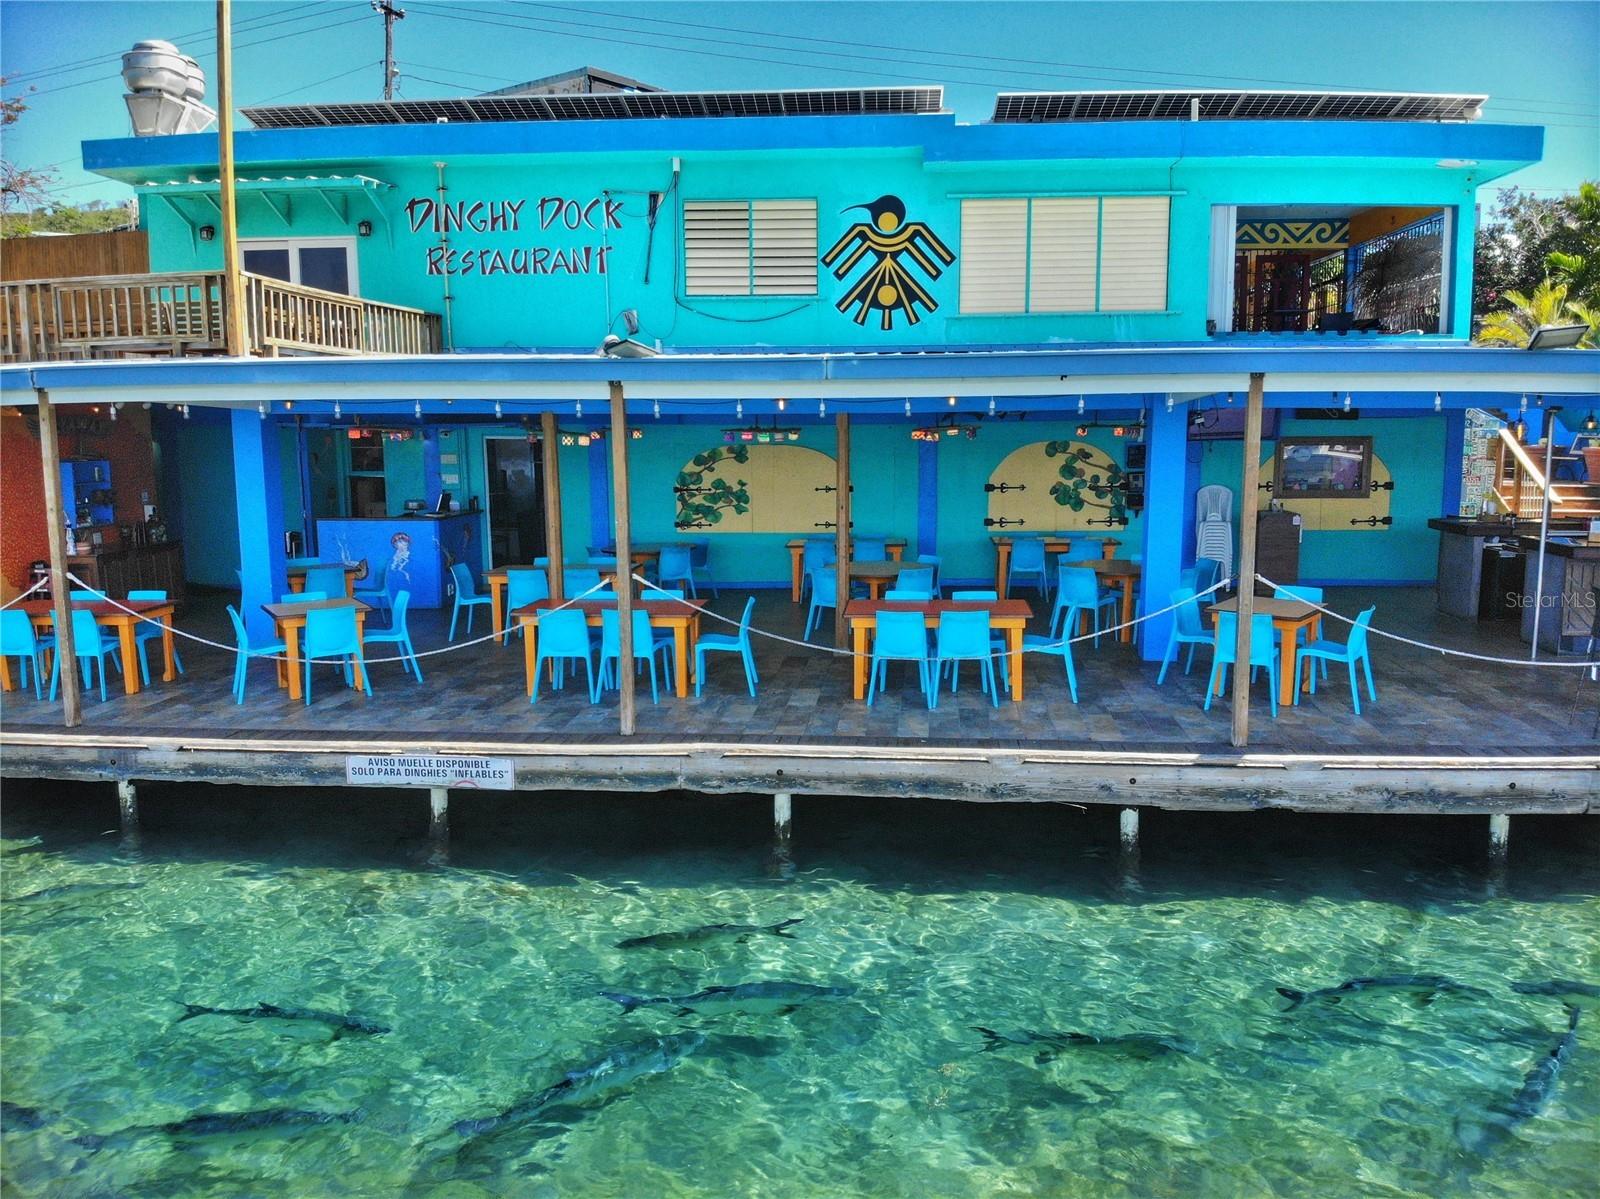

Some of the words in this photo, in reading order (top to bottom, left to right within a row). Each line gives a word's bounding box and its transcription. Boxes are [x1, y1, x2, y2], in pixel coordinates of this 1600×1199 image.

[404, 197, 526, 233] DINGHY
[536, 197, 625, 231] DOCK
[426, 246, 613, 276] RESTAURANT
[352, 767, 375, 776] SOLO
[377, 768, 402, 777] PARA
[405, 769, 448, 778] DINGHIES
[450, 769, 508, 779] "INFLABLES"
[368, 758, 395, 767] AVISO
[398, 758, 433, 768] MUELLE
[436, 759, 491, 769] DISPONIBLE
